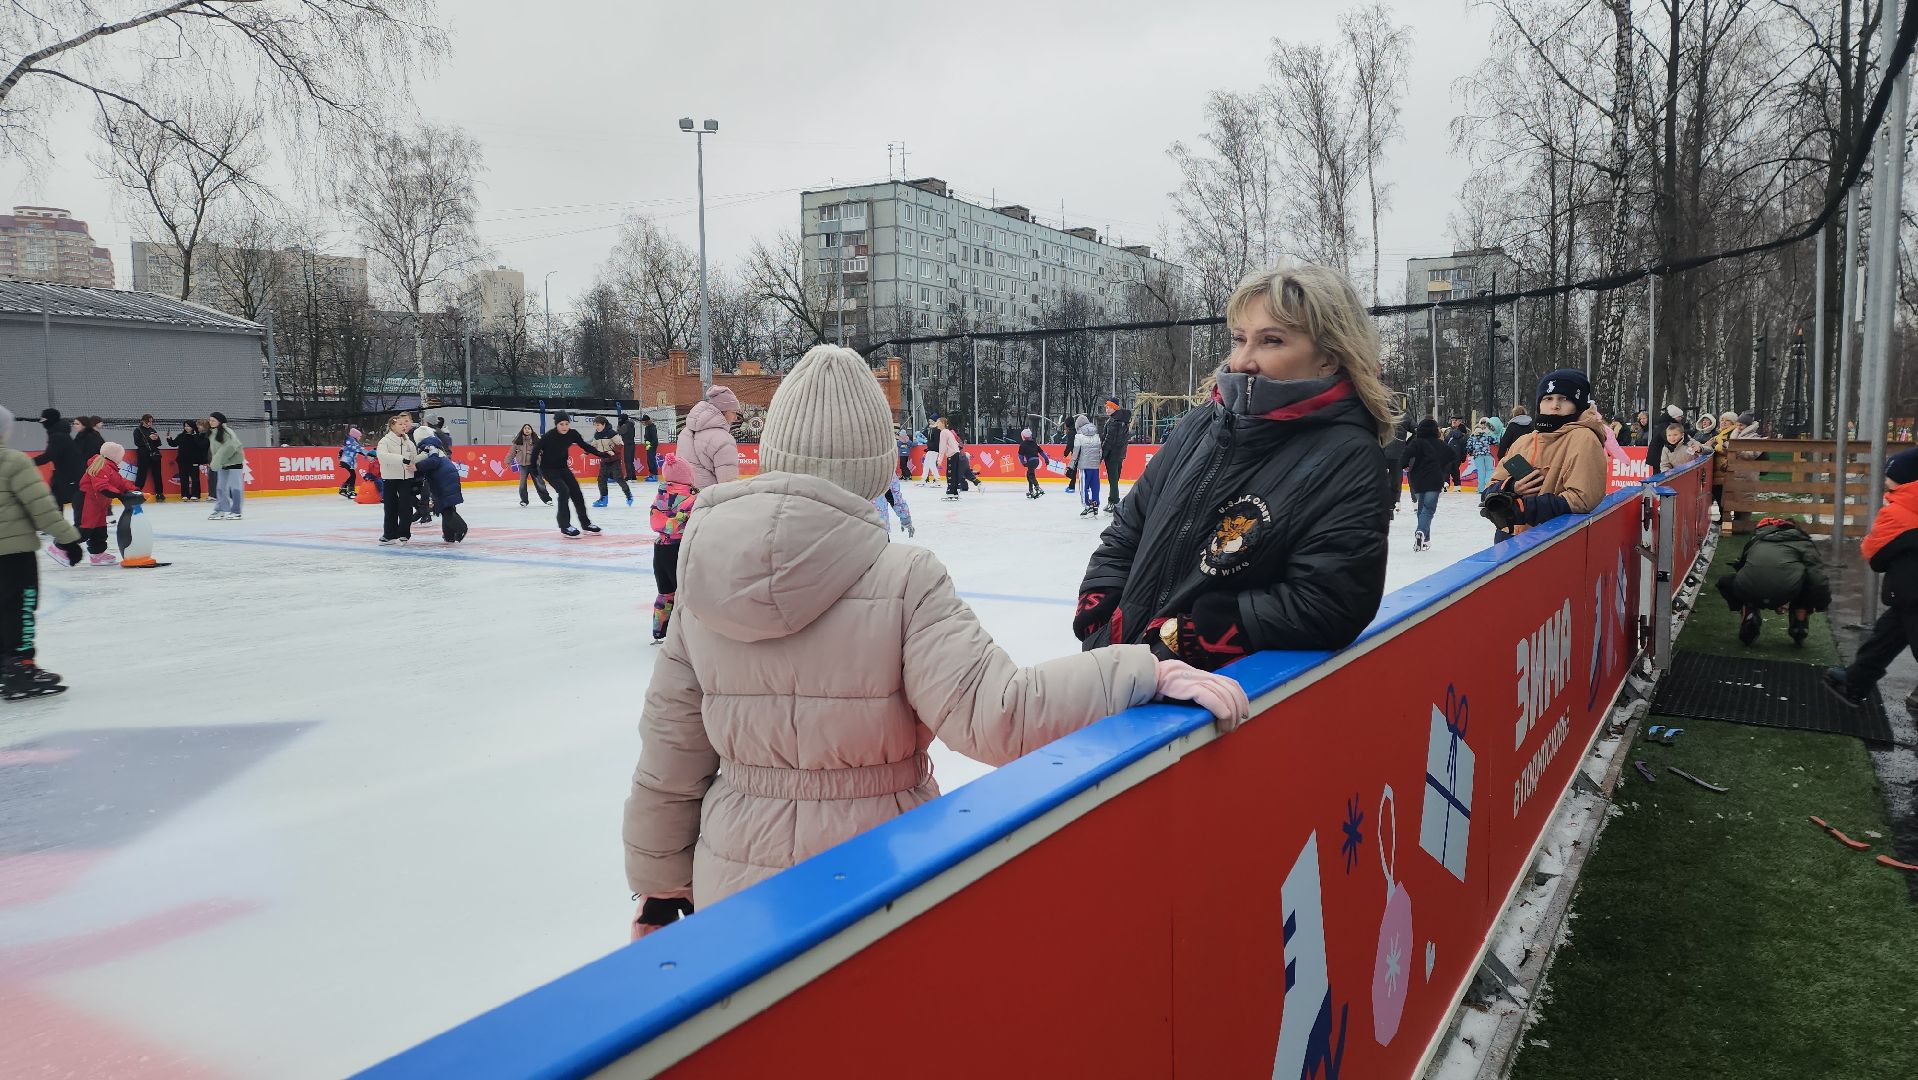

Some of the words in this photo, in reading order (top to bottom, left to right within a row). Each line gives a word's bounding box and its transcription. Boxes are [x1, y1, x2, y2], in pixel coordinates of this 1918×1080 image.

[279, 456, 335, 473] ЗИМА
[1612, 458, 1649, 477] ЗИМА
[285, 473, 335, 482] ПОДМОСКОВЬЕ
[1515, 598, 1571, 752] ЗИМА
[1513, 778, 1520, 819] В
